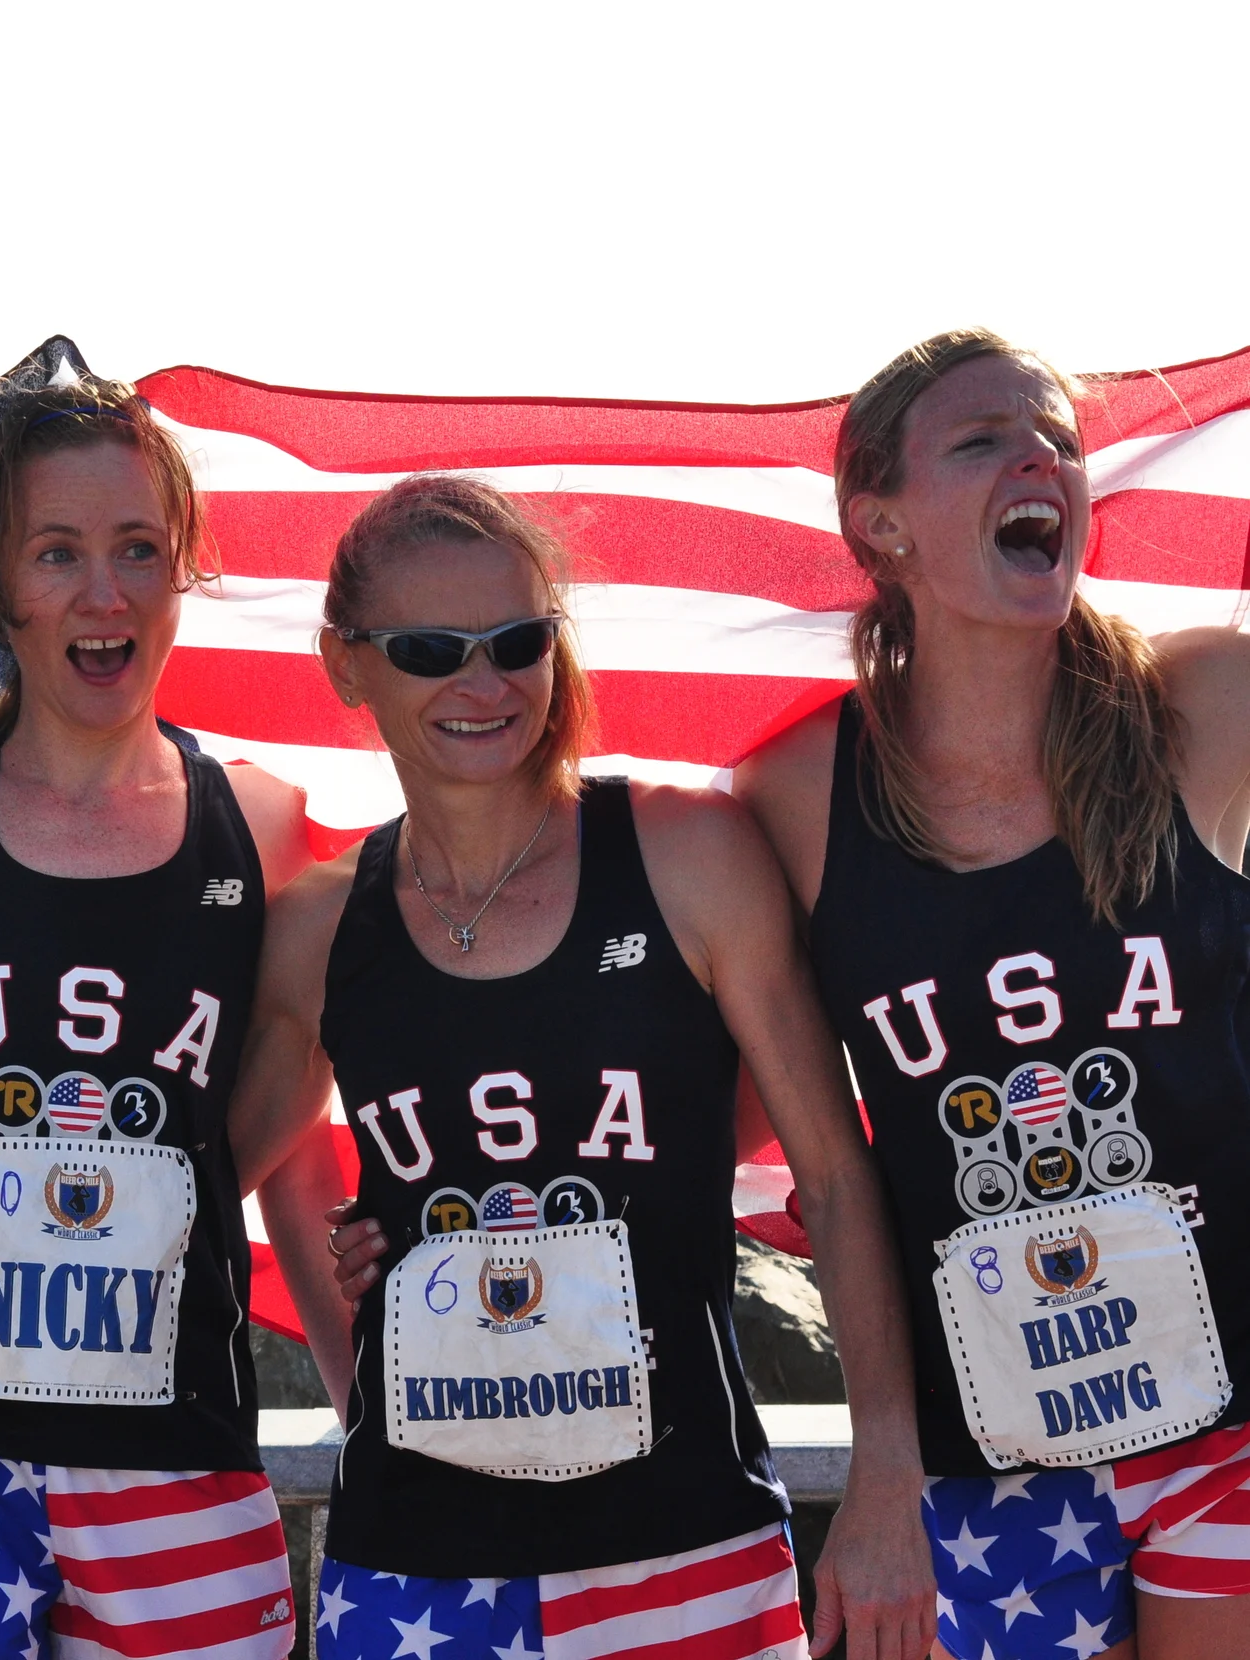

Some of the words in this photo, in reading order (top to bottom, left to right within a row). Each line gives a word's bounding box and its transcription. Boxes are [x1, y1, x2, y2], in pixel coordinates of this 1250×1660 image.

[200, 878, 244, 906] NB
[598, 932, 647, 973] NB
[862, 936, 1183, 1079] USA
[356, 1068, 656, 1183] USA
[60, 1175, 77, 1185] BEER
[85, 1175, 100, 1186] MILE
[57, 1230, 76, 1239] WORLD
[77, 1230, 98, 1239] CLASSIC
[1039, 1243, 1056, 1254] BEER
[1064, 1238, 1079, 1248] MILE
[425, 1254, 458, 1315] 6
[513, 1269, 528, 1279] MILE
[969, 1246, 1004, 1295] 8
[1051, 1295, 1071, 1305] WORLD
[1072, 1289, 1094, 1300] CLASSIC
[491, 1321, 509, 1333] WORLD
[511, 1320, 532, 1332] CLASSIC
[1020, 1296, 1138, 1371] HARP
[404, 1364, 632, 1421] KIMBROUGH
[1036, 1361, 1162, 1438] DAWG
[1016, 1448, 1025, 1457] 8
